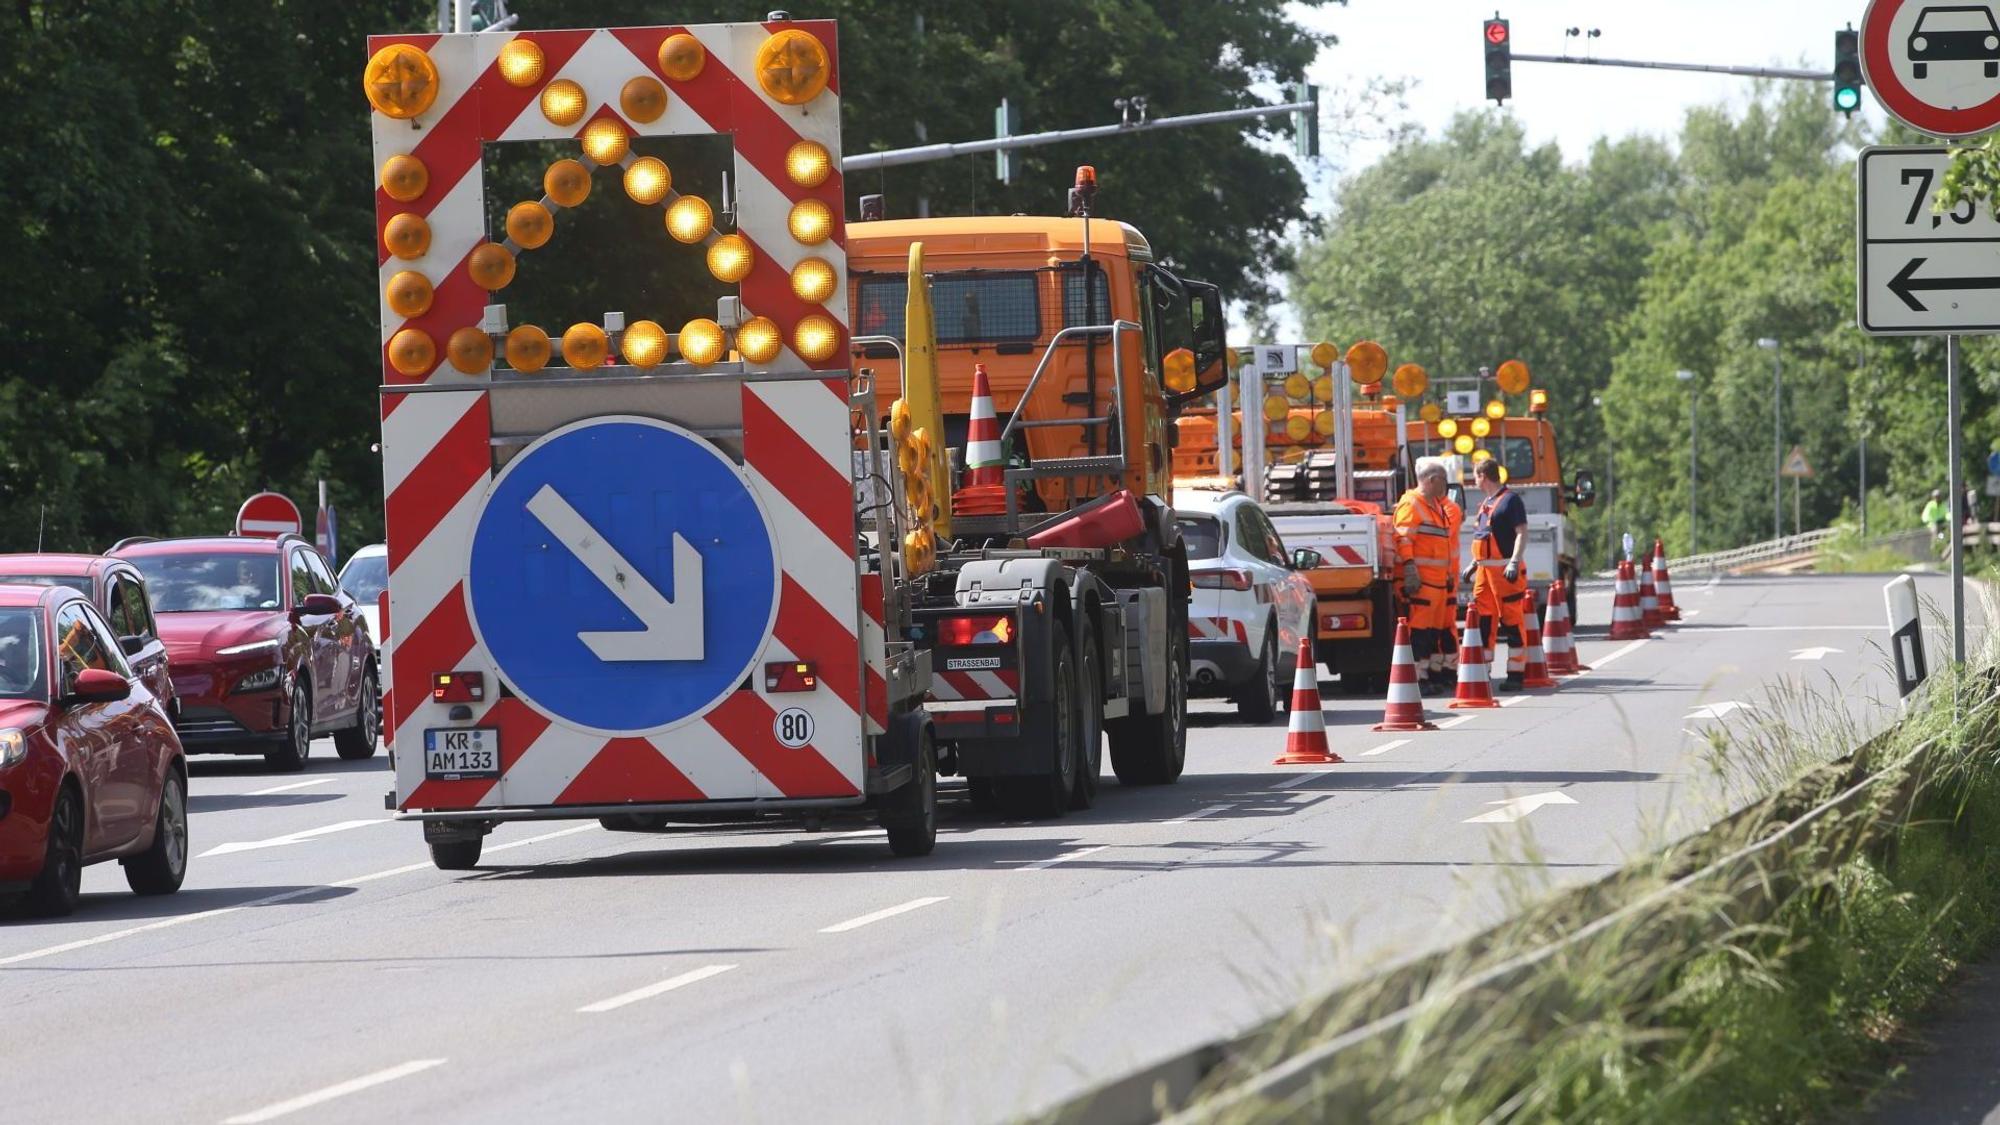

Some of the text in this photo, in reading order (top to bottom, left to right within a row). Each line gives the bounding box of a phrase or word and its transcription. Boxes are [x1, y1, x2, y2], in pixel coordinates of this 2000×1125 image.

[948, 659, 999, 668] STRASSENBAU
[782, 714, 807, 740] 80
[445, 733, 469, 750] KR
[432, 752, 492, 770] AM 133
